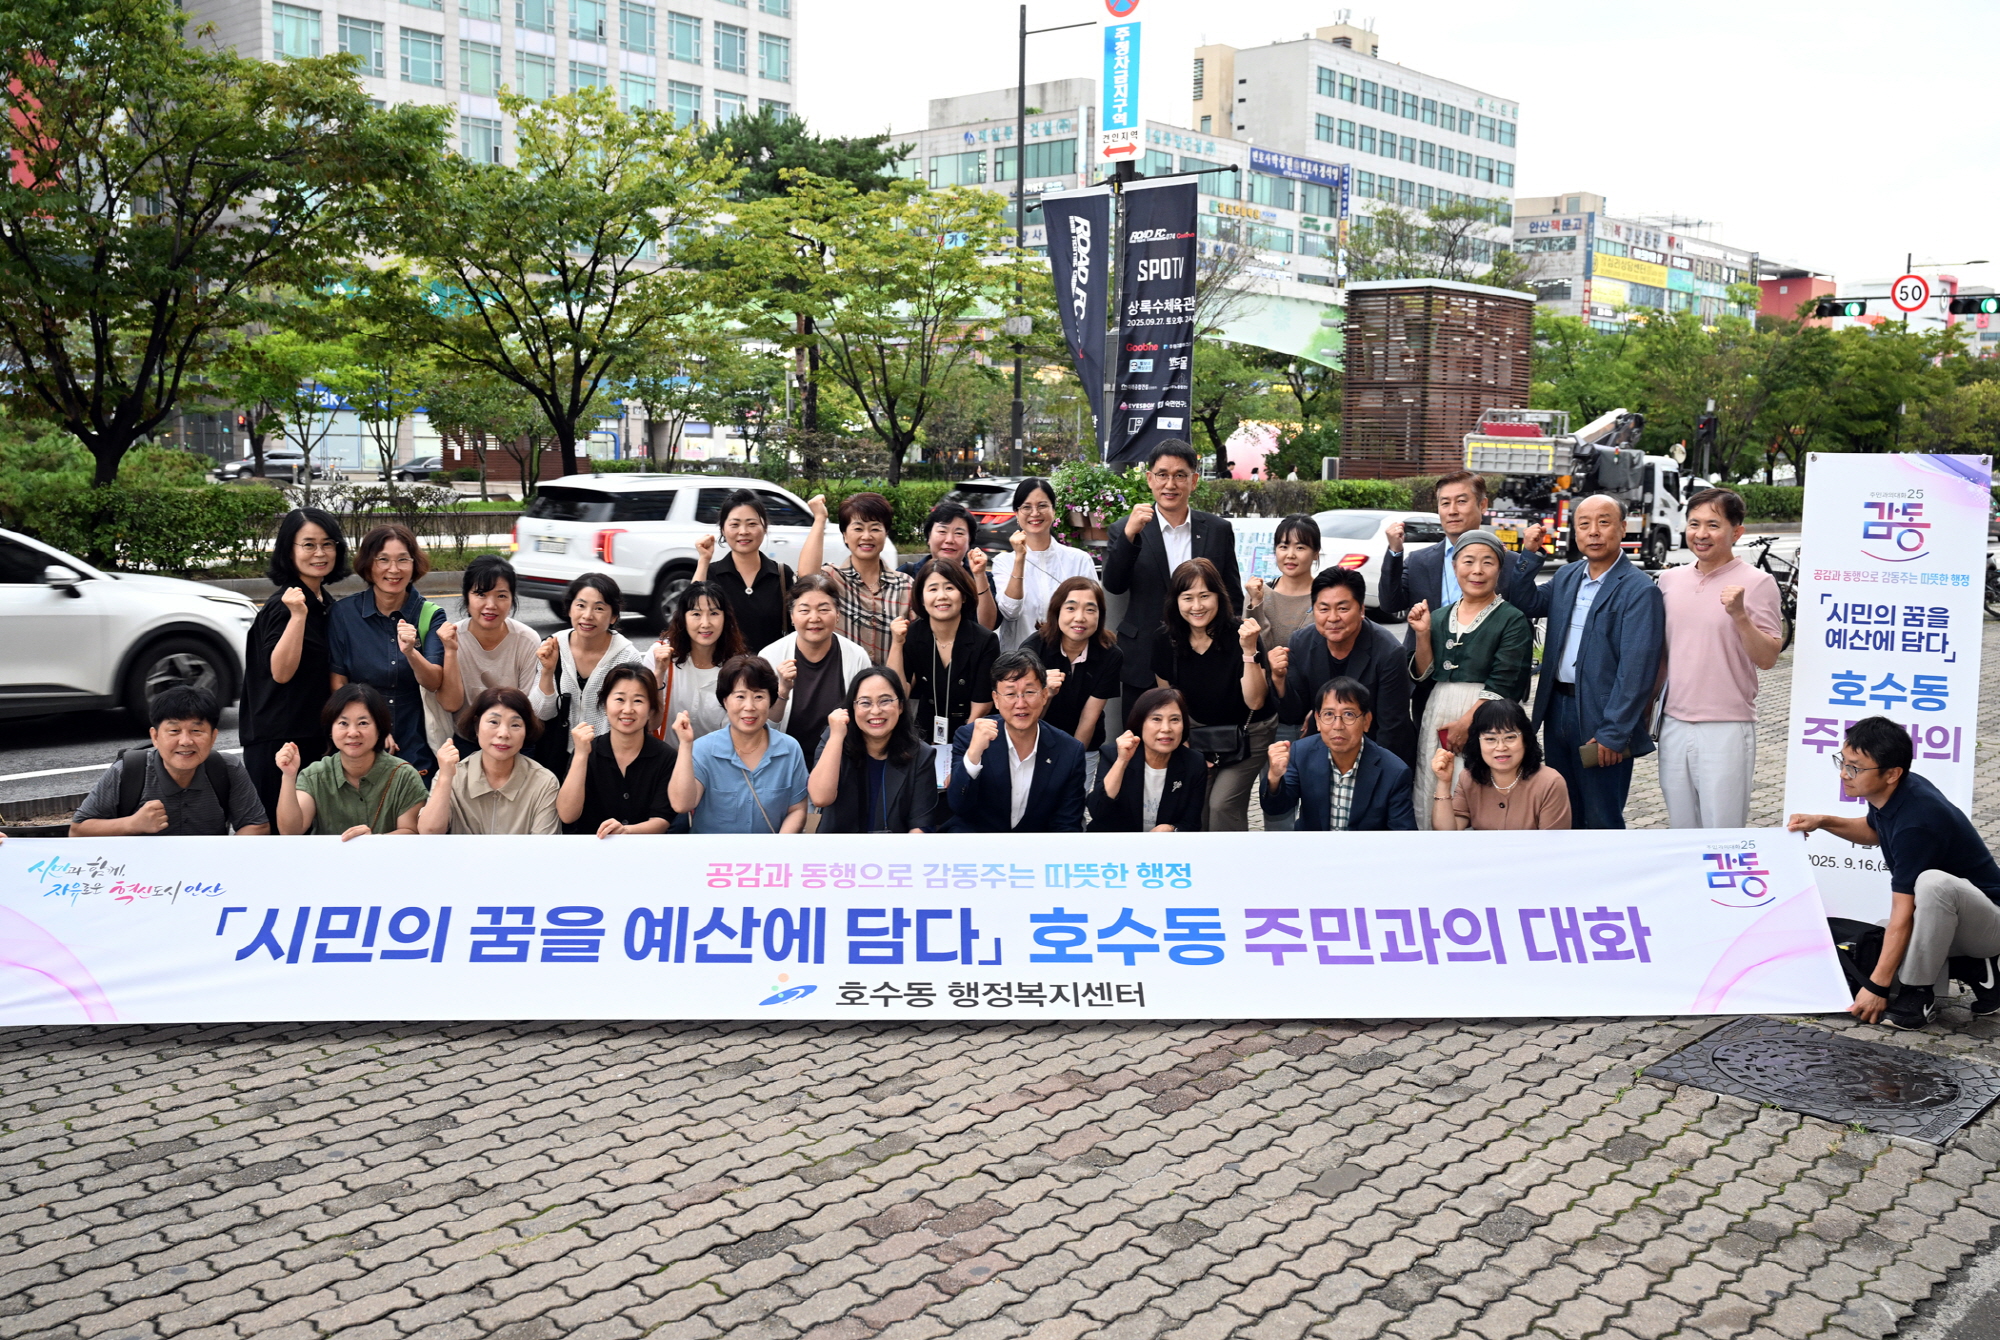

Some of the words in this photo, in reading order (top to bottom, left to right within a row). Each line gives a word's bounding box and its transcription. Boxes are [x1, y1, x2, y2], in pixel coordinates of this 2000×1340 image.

[1112, 26, 1130, 126] 주정차금지구역
[1103, 131, 1138, 143] 견인지역
[1130, 229, 1154, 241] ROAD
[1154, 228, 1167, 240] FC
[1529, 217, 1582, 234] 안산책문고
[1074, 215, 1091, 285] ROAD
[1137, 257, 1184, 281] SPOTV
[1073, 286, 1088, 320] FC
[1127, 296, 1195, 315] 상록수체육관
[1900, 285, 1922, 301] 50
[1863, 501, 1931, 552] 감동
[1813, 569, 1841, 582] 공감과
[1843, 570, 1879, 583] 동행으로
[1881, 571, 1918, 585] 감동주는
[1920, 573, 1948, 587] 따뜻한
[1950, 574, 1970, 587] 행정
[1903, 605, 1950, 629] 꿈을
[1825, 628, 1895, 652] 예산에
[1828, 670, 1949, 712] 호수동
[28, 855, 86, 884] 시민과
[706, 862, 793, 889] 공감과
[800, 862, 913, 889] 동행으로
[922, 862, 1036, 889] 감동주는
[1045, 862, 1130, 889] 따뜻한
[1136, 862, 1192, 889] 행정
[1702, 852, 1770, 898] 감동
[43, 882, 105, 907] 자유로운
[109, 880, 182, 906] 혁신도시
[184, 882, 227, 897] 안산
[215, 905, 453, 965] 「시민의
[469, 905, 606, 964] 꿈을
[623, 906, 826, 965] 예산에
[847, 907, 1002, 966] 담다」
[1029, 907, 1226, 966] 호수동
[1244, 906, 1508, 966] 주민과의
[1519, 905, 1652, 965] 대화
[835, 980, 938, 1009] 호수동
[947, 980, 1146, 1009] 행정복지센터
